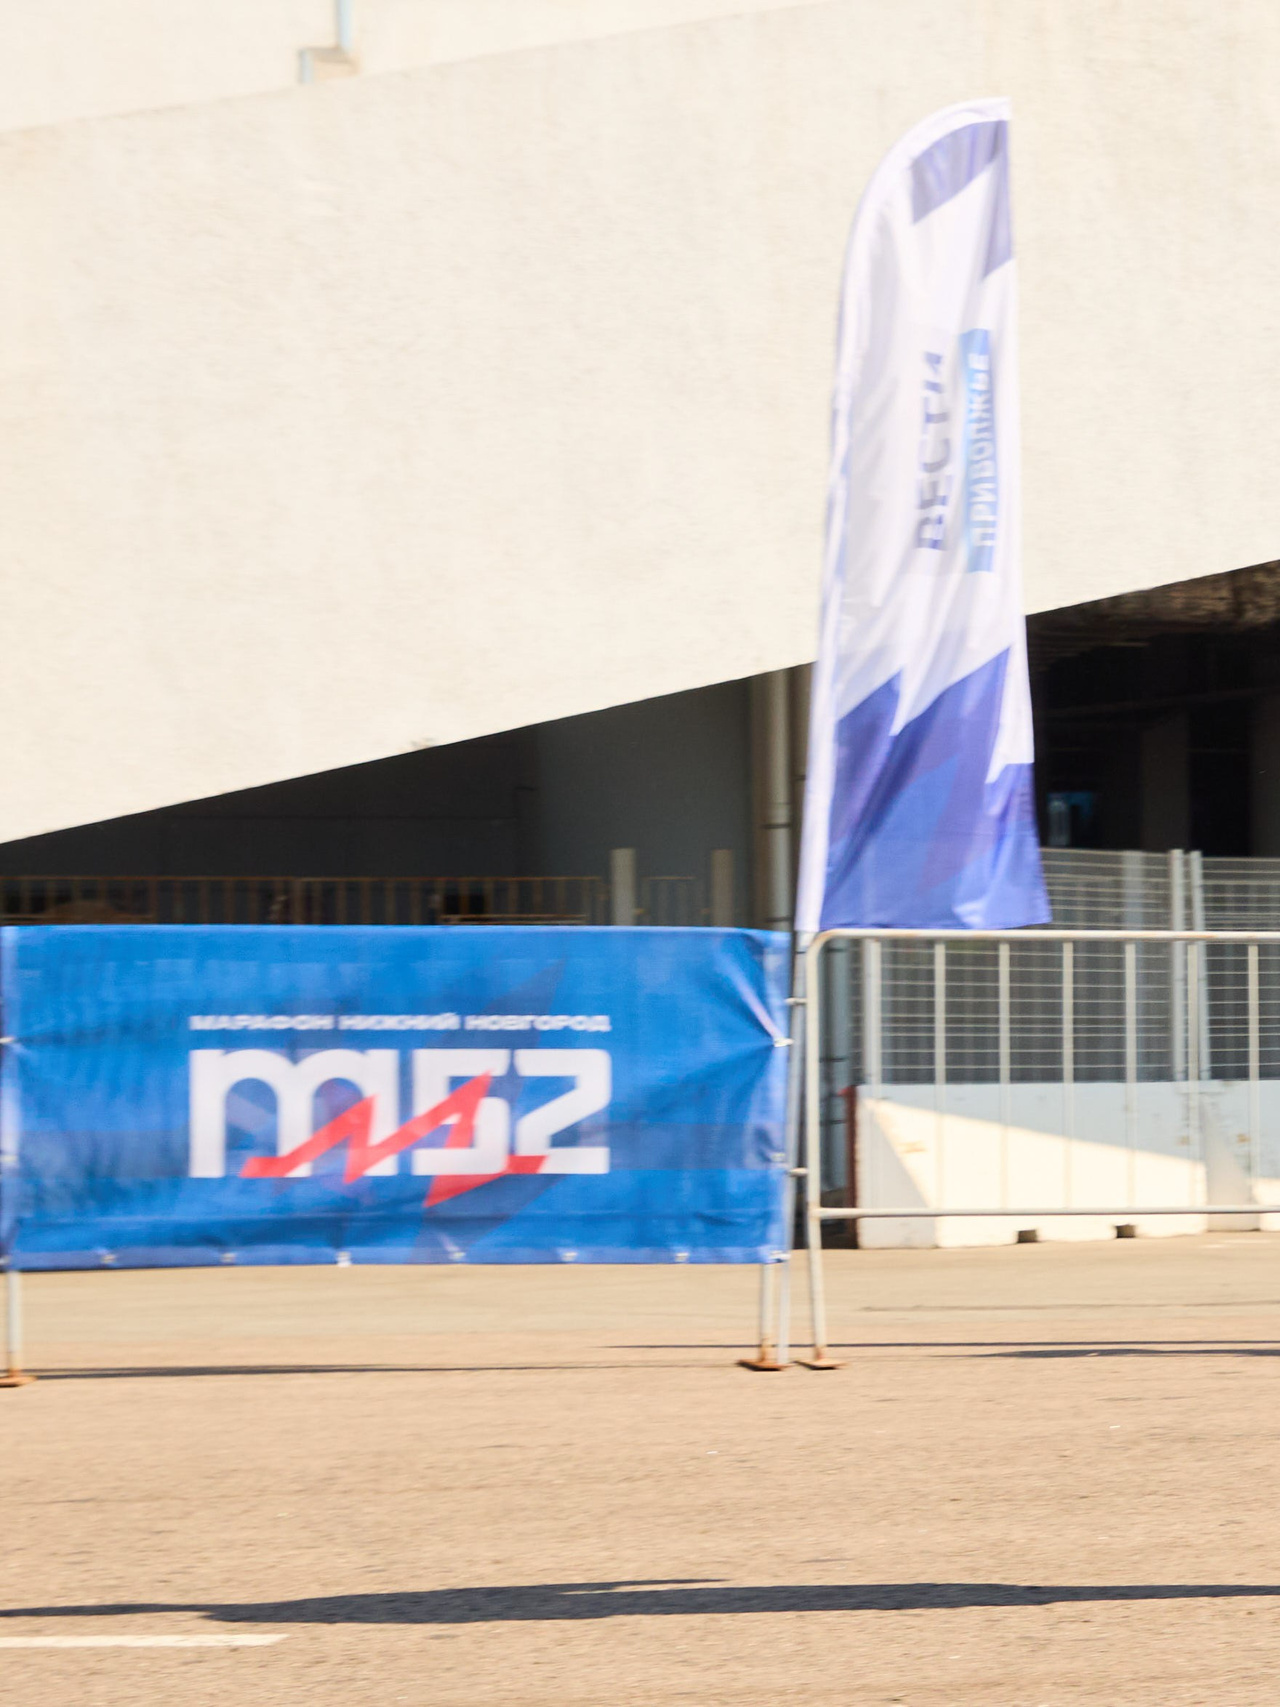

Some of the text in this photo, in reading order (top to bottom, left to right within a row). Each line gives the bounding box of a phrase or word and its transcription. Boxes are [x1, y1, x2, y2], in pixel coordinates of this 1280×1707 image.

[968, 353, 996, 547] ПРИВОЛЖЬЕ
[190, 1013, 613, 1032] МАРАФОН НИЖНИЙ НОВГОРОД
